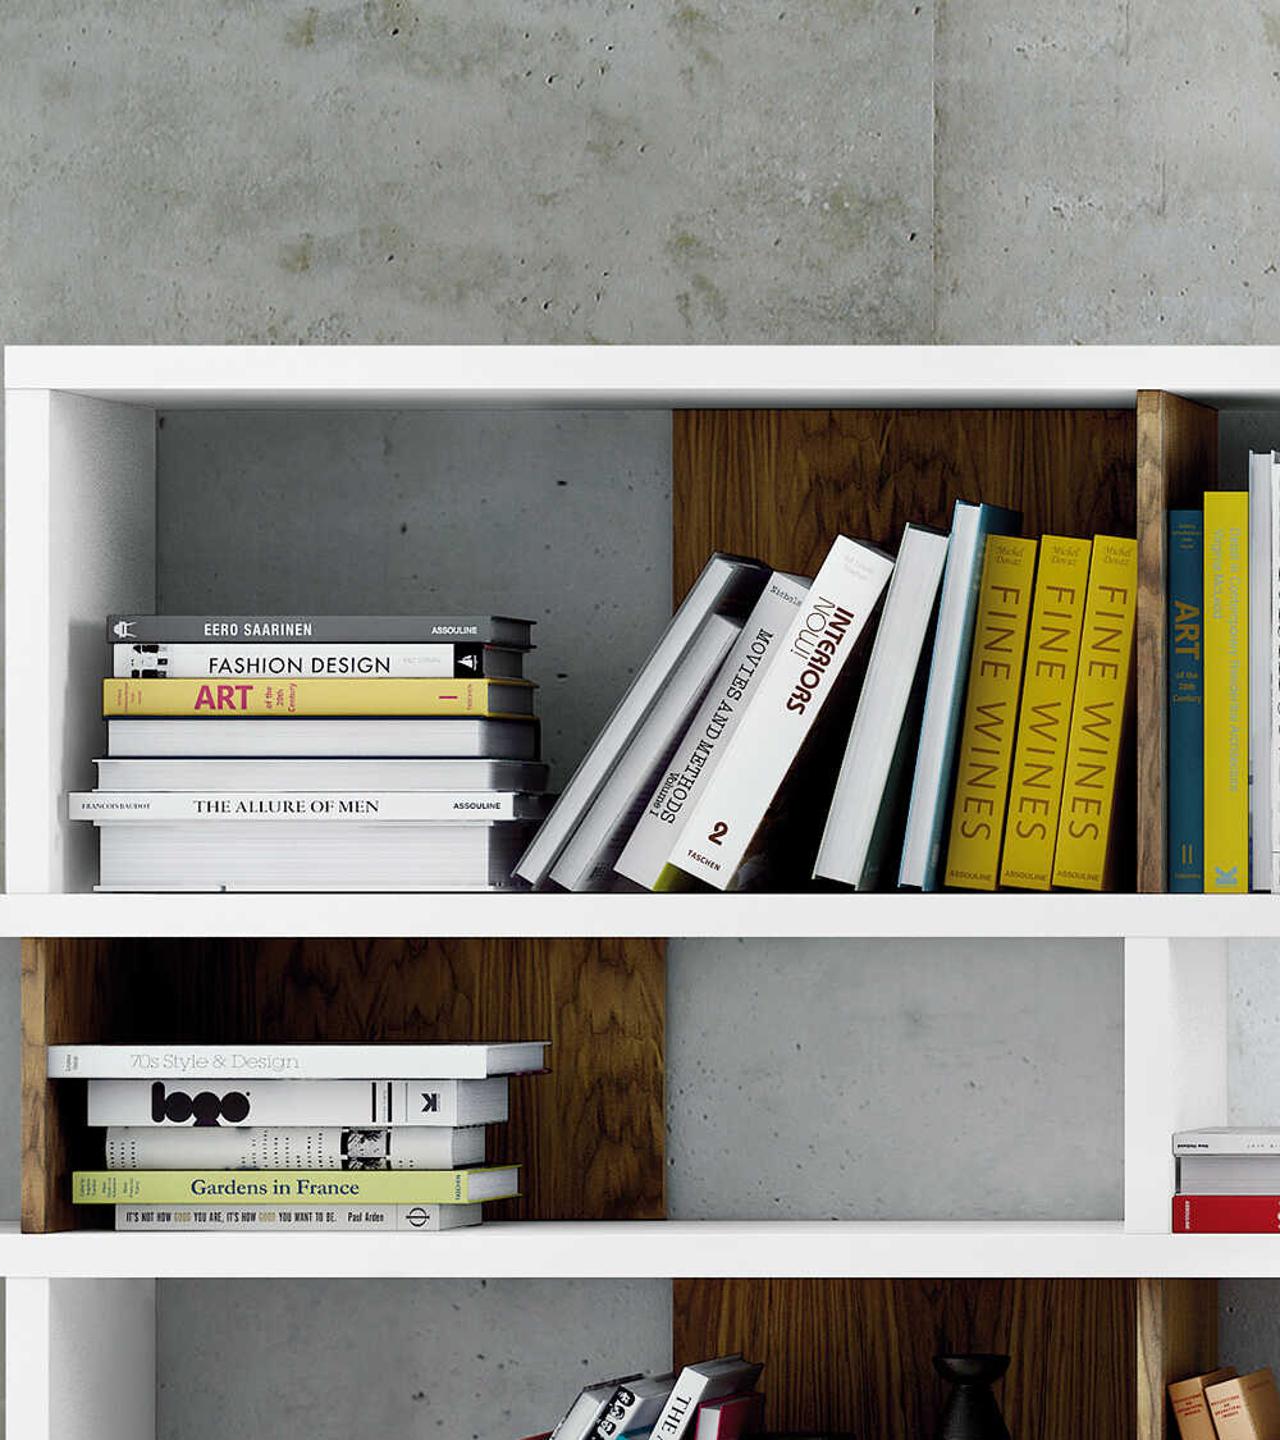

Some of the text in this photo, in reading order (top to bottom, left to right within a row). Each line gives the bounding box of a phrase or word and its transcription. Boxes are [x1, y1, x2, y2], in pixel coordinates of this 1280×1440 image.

[204, 623, 312, 636] EERO SAARINEN
[431, 626, 478, 635] ASSOULINE
[1174, 601, 1200, 661] ART
[209, 657, 302, 674] FASHION
[311, 657, 391, 674] DESIGN
[786, 606, 854, 716] INTERIORS
[194, 685, 254, 710] ART
[961, 585, 1020, 841] FINE WINES
[1016, 585, 1075, 841] FINE WINES
[1069, 585, 1127, 841] FINE WINES
[660, 628, 774, 824] MOVIES AND METHODS
[193, 800, 379, 814] THE ALLURE OF MEN
[453, 802, 501, 810] ASSOULINE
[708, 821, 729, 846] 2
[130, 1053, 300, 1072] 70s Style & Design
[191, 1179, 359, 1196] Gardens in France
[156, 1211, 171, 1223] HOW
[194, 1211, 207, 1223] YOU
[241, 1211, 256, 1223] HOW
[279, 1211, 292, 1223] YOU
[294, 1211, 313, 1223] WANT
[661, 1396, 692, 1435] THE
